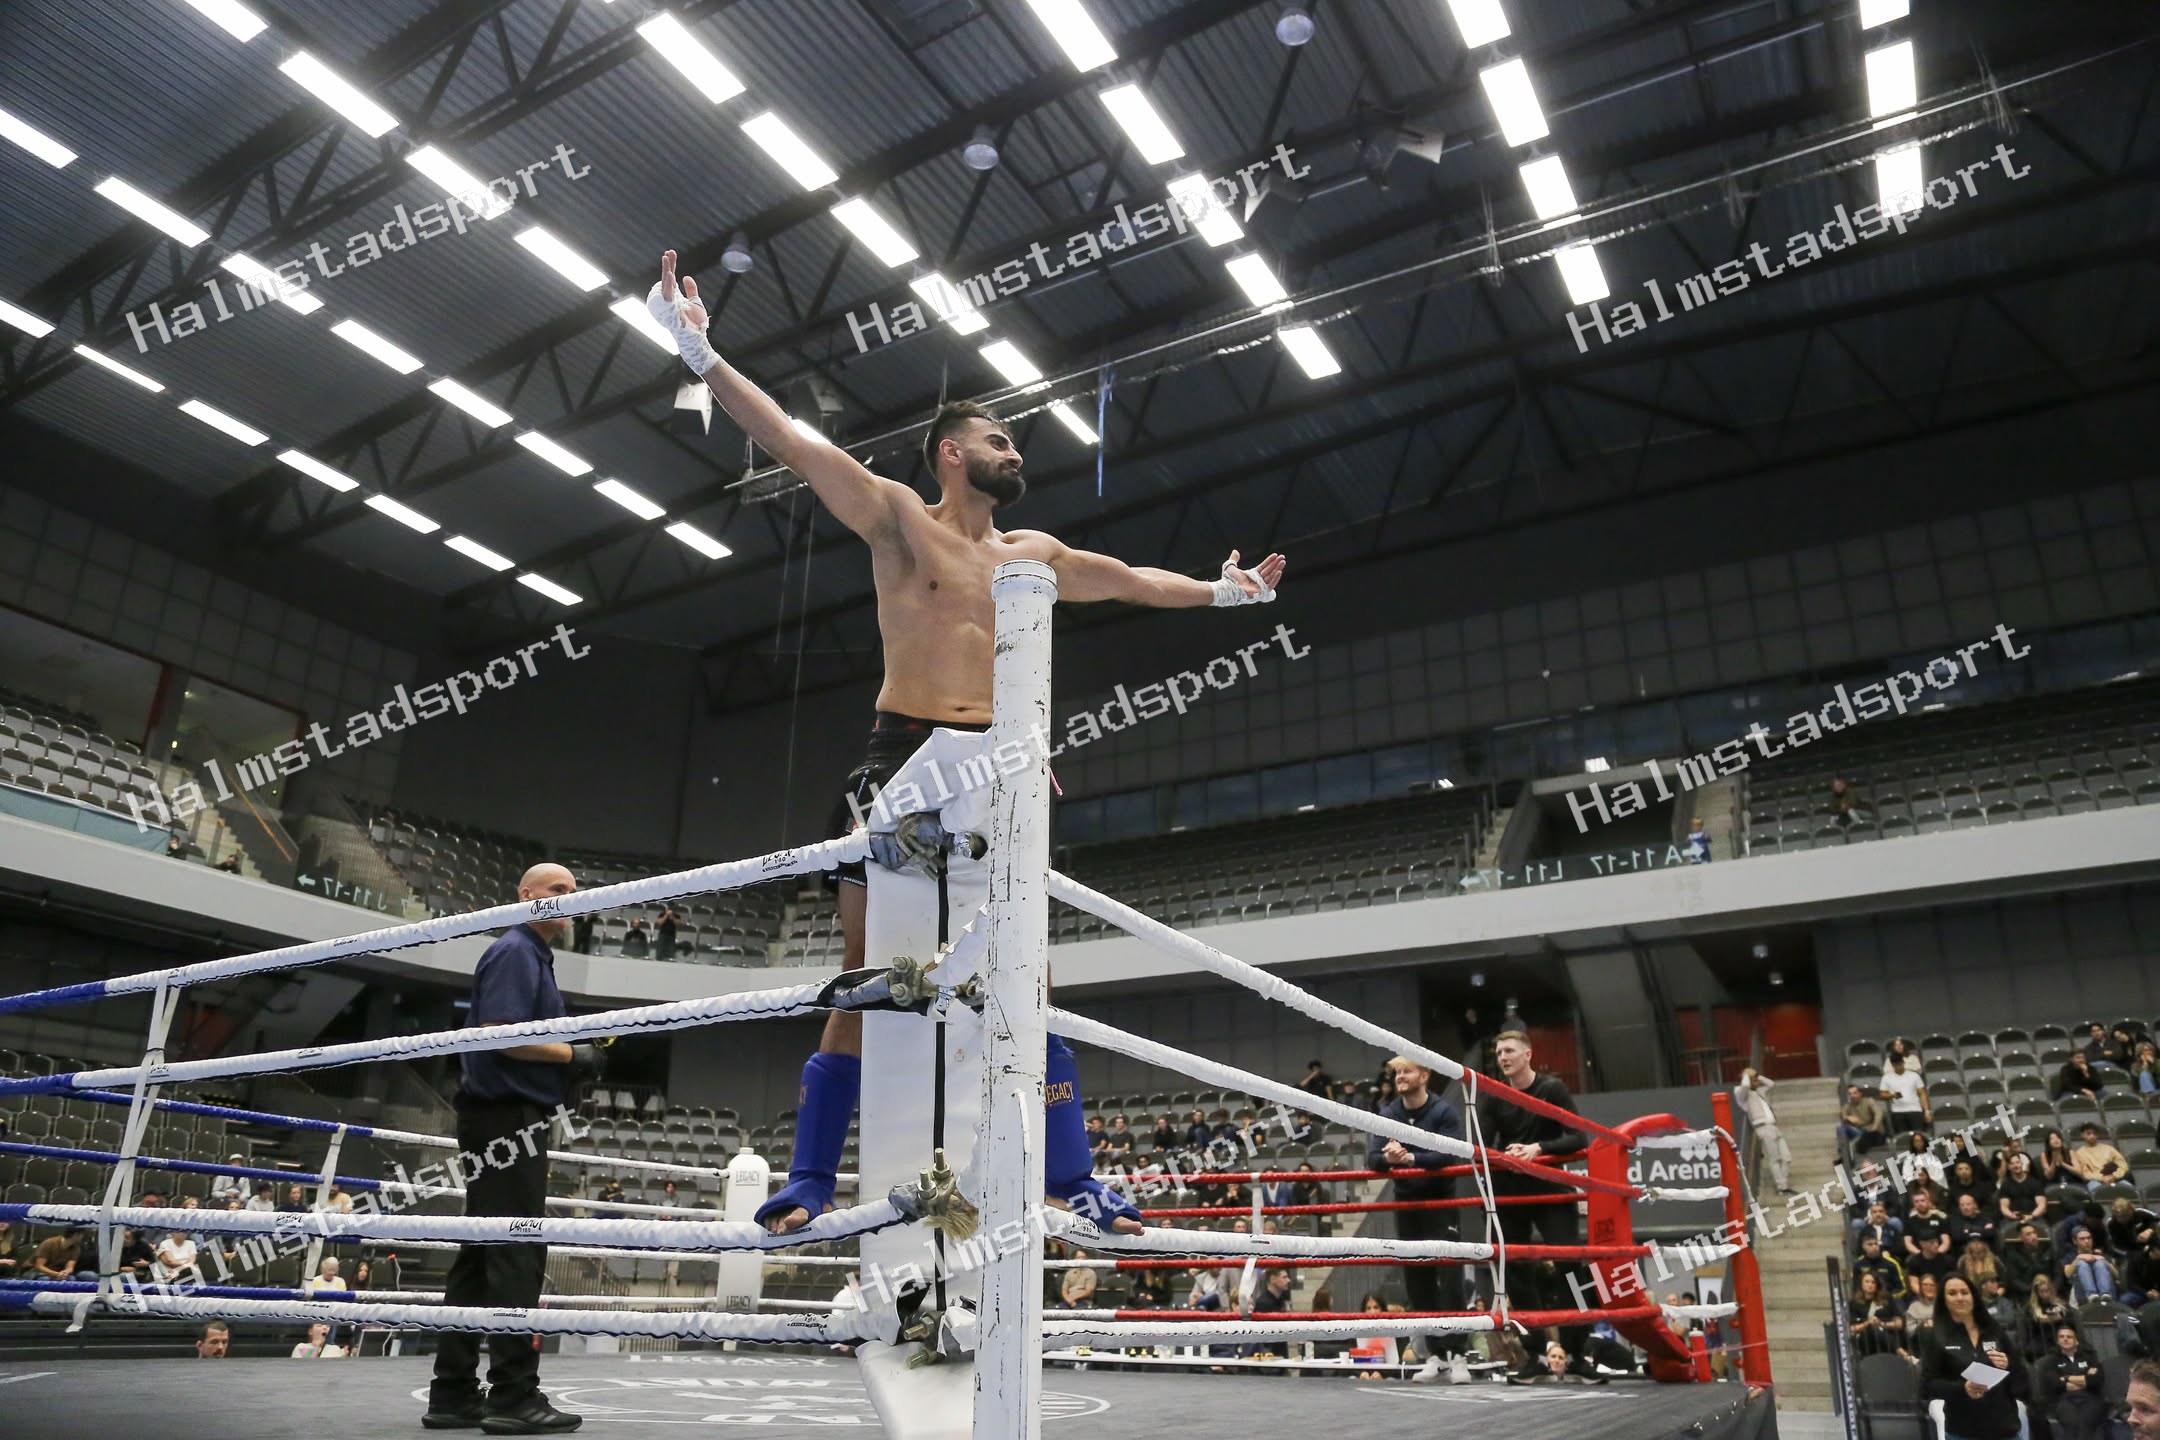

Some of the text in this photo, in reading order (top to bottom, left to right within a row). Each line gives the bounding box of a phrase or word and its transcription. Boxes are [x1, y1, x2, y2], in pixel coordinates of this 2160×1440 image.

[1045, 1081, 1074, 1105] EGACY
[1649, 1159, 1722, 1182] Arena
[726, 1295, 752, 1308] LEGACY
